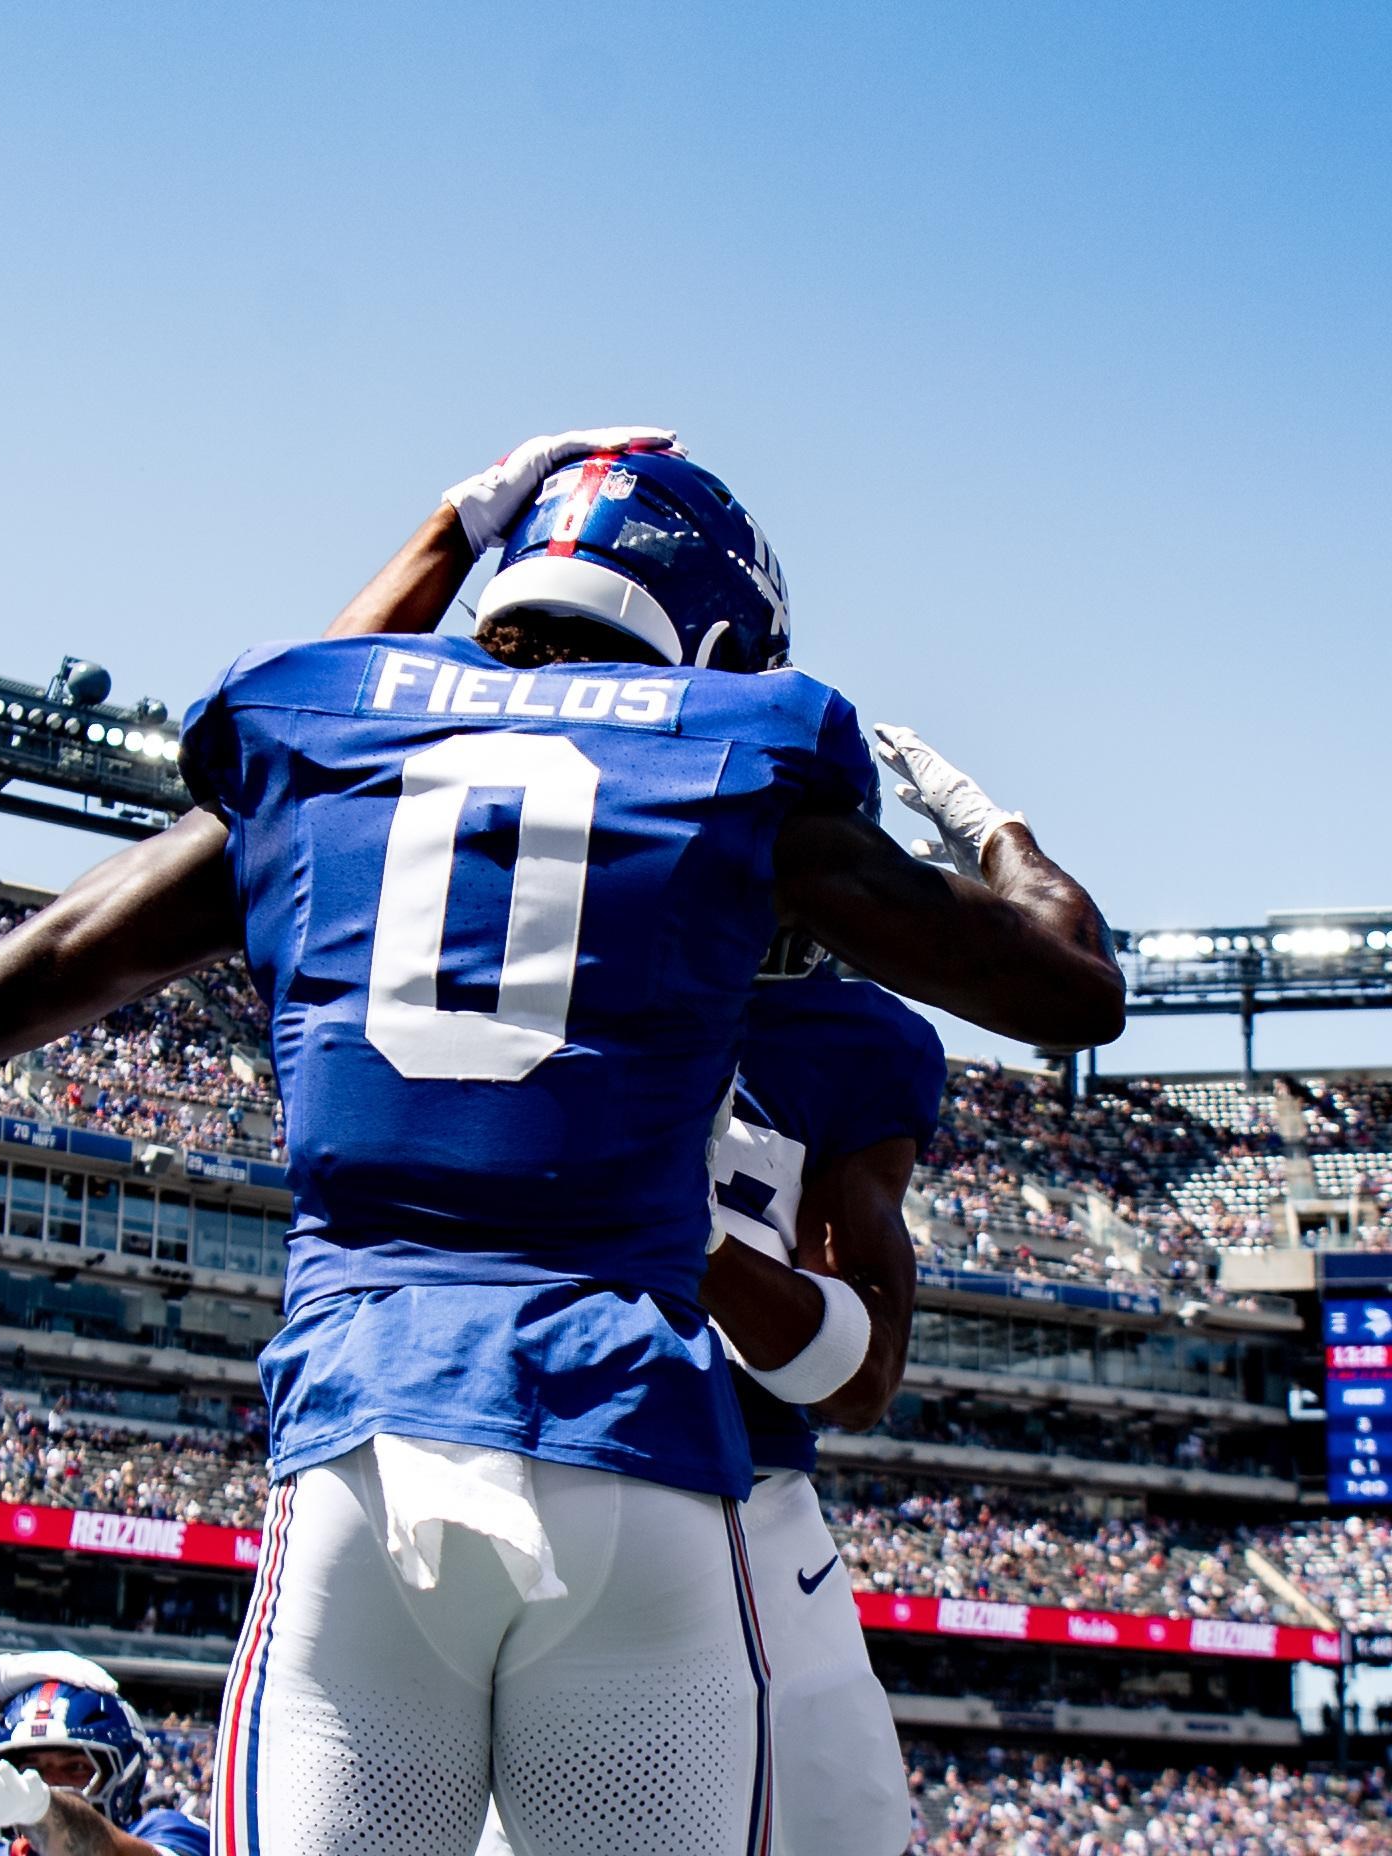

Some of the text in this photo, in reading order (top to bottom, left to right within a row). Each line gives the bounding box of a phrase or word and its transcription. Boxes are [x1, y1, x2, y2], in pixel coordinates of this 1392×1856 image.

[371, 651, 675, 722] FIELDS
[365, 732, 600, 1081] 0
[69, 1510, 188, 1560] REDZONE
[936, 1597, 1031, 1639] REDZONE
[1189, 1618, 1279, 1659] REDZONE
